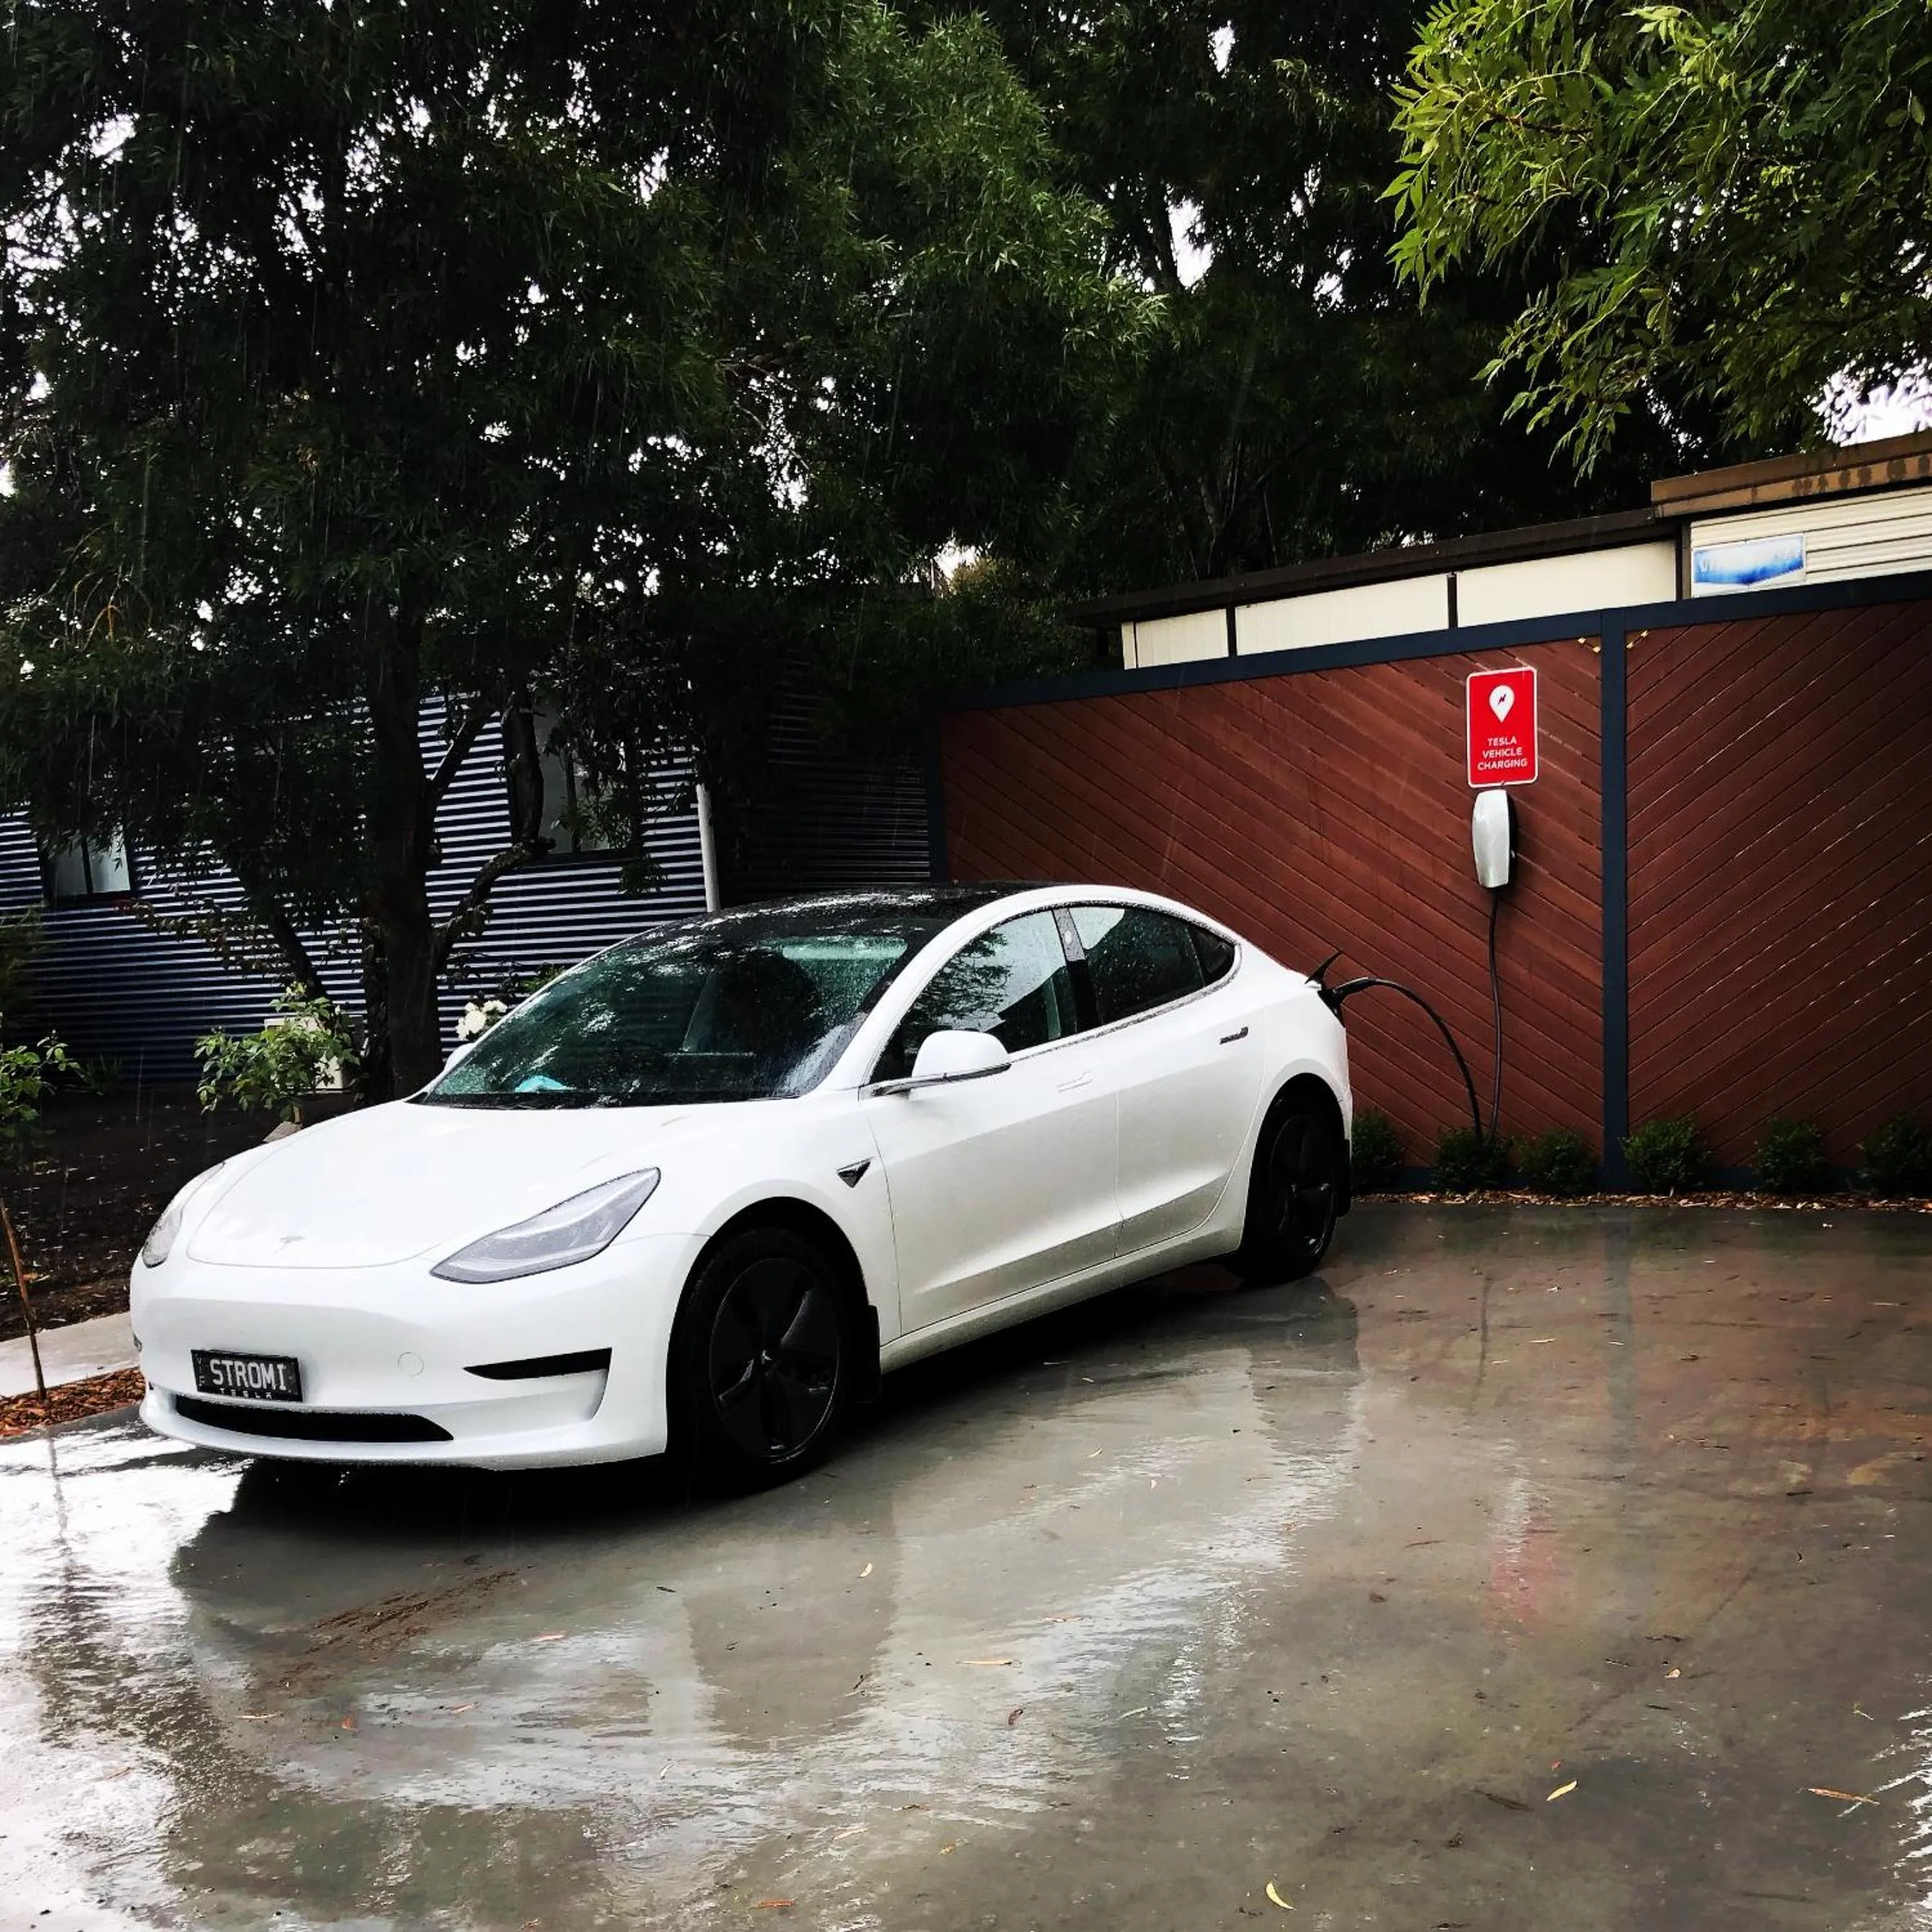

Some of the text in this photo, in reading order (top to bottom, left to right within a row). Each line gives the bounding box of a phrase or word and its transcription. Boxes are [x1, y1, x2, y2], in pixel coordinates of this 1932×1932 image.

[1487, 736, 1517, 746] TESLA
[1482, 747, 1522, 758] VEHICLE
[1477, 758, 1527, 770] CHARGING
